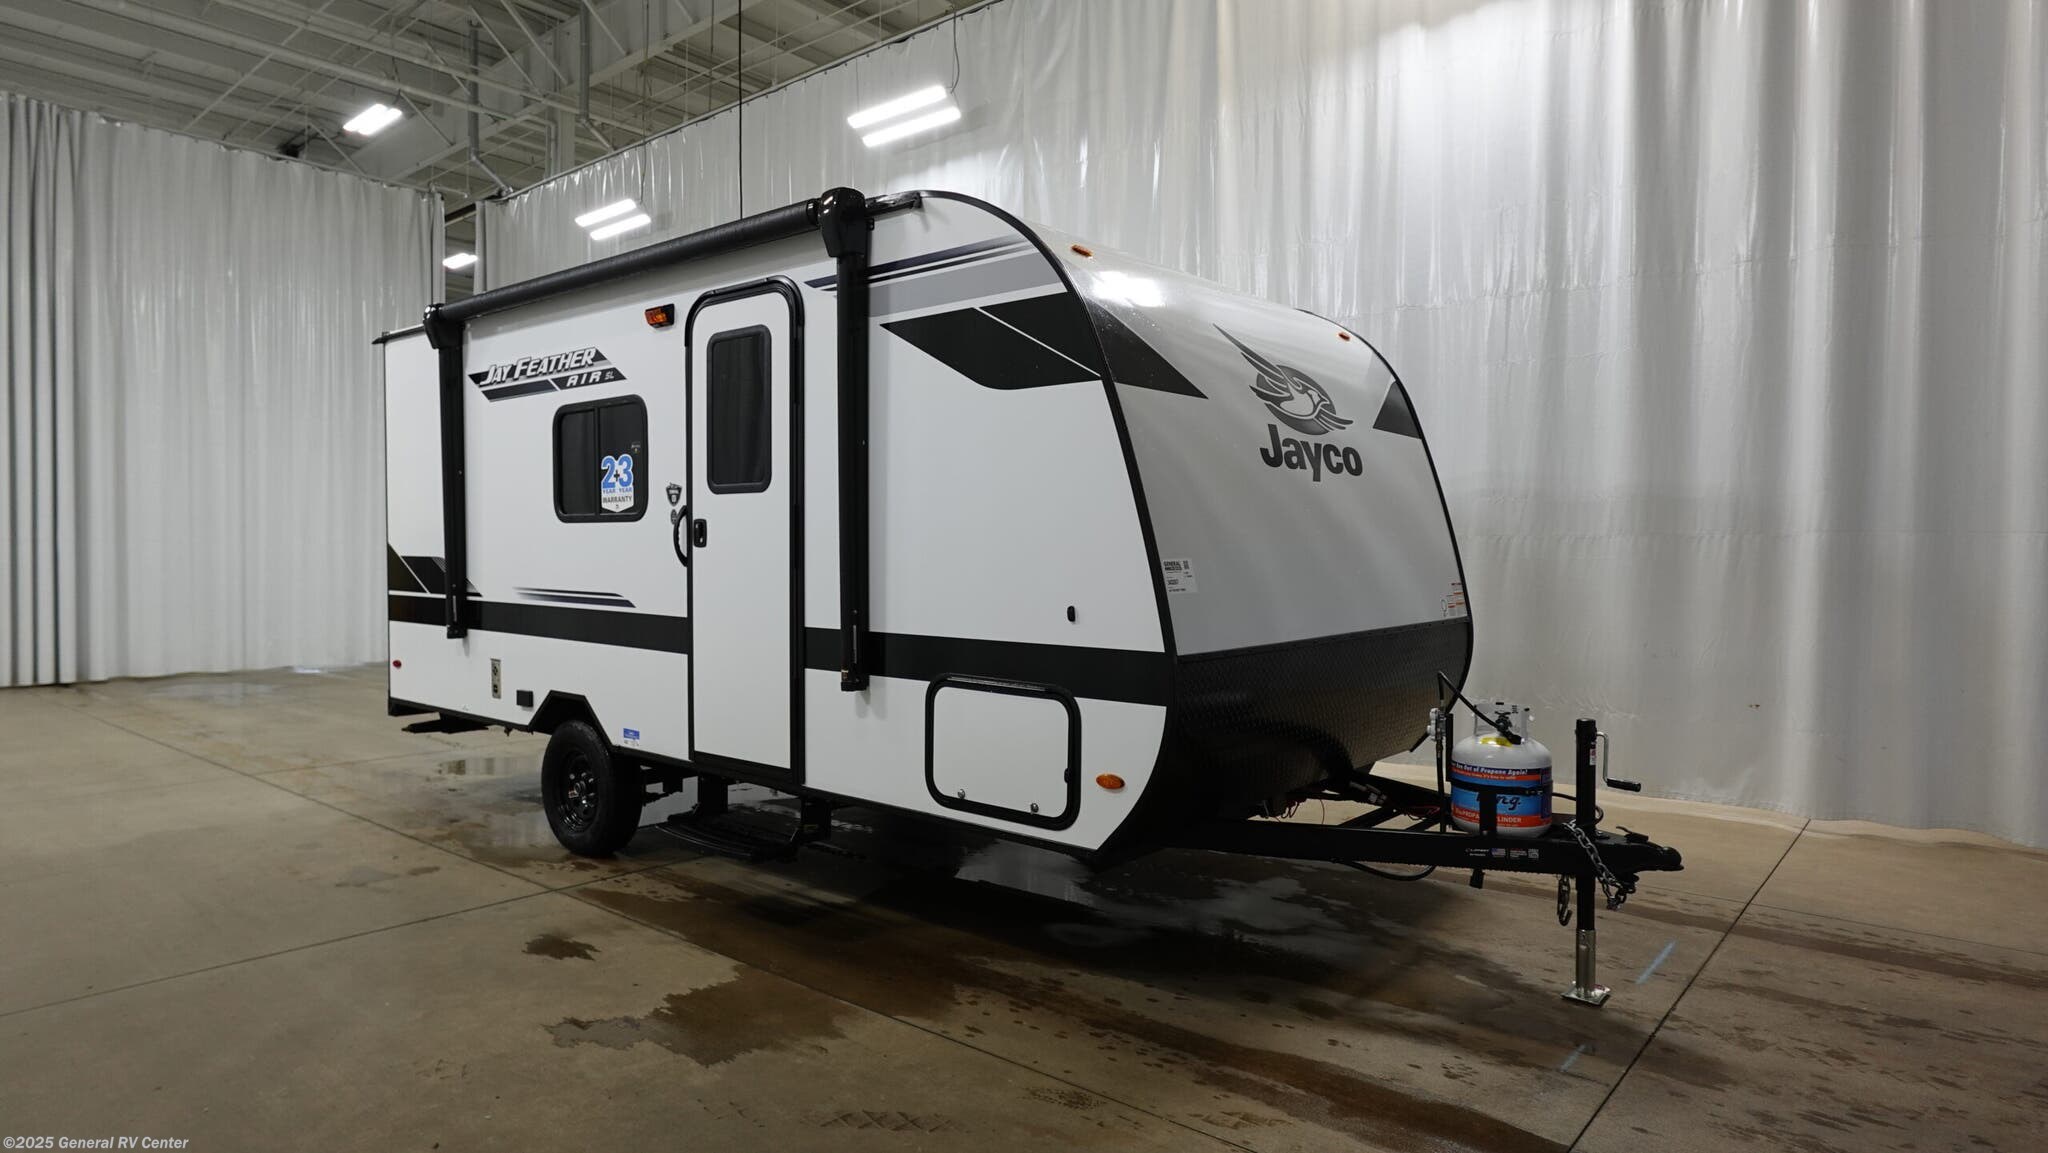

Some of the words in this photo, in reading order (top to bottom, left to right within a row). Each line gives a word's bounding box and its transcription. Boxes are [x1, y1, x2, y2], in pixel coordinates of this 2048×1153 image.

[478, 364, 512, 387] JAY
[513, 347, 597, 380] FEATHER
[566, 371, 602, 387] AIR
[604, 370, 615, 380] SL
[1259, 423, 1363, 482] Jayco
[1480, 767, 1506, 775] Propane
